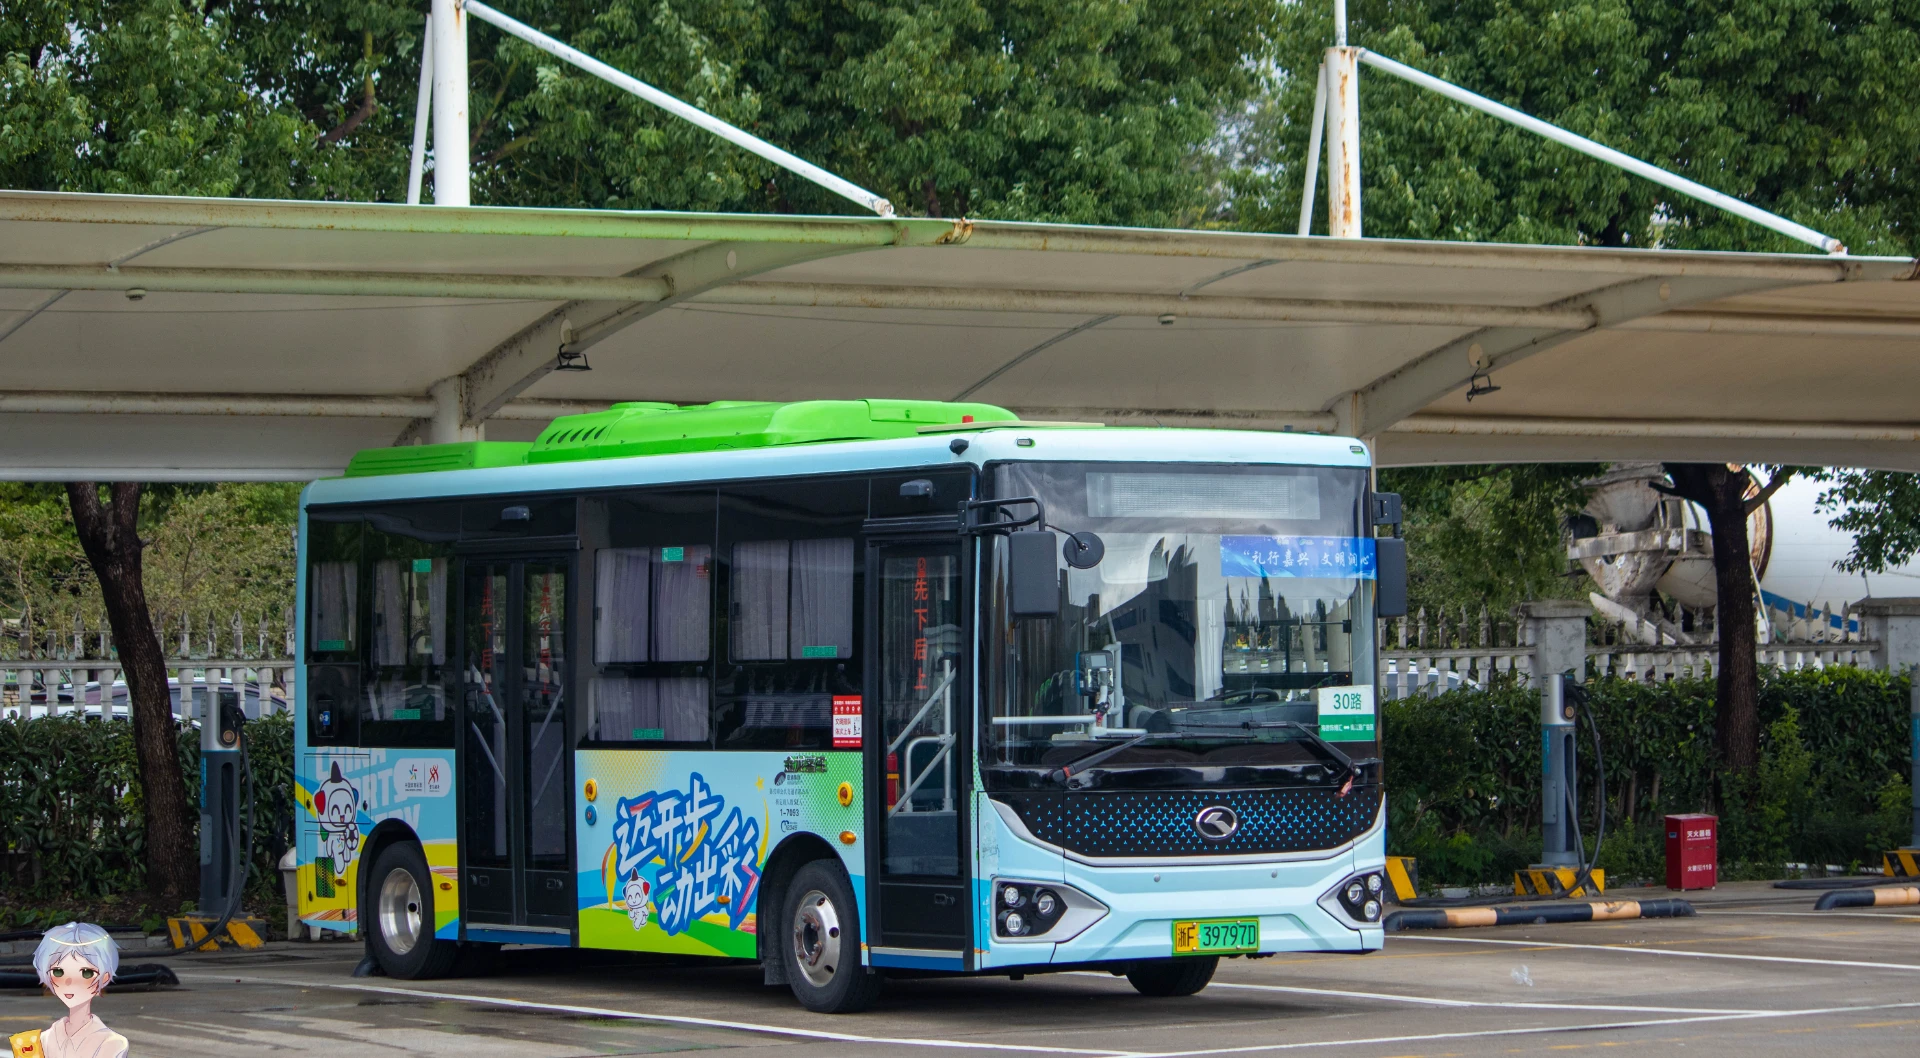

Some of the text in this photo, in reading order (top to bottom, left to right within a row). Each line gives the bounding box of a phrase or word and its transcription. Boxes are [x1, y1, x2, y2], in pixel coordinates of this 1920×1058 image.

[914, 578, 928, 690] 先下后上
[1333, 693, 1362, 711] 30路
[1202, 924, 1257, 947] 39797D
